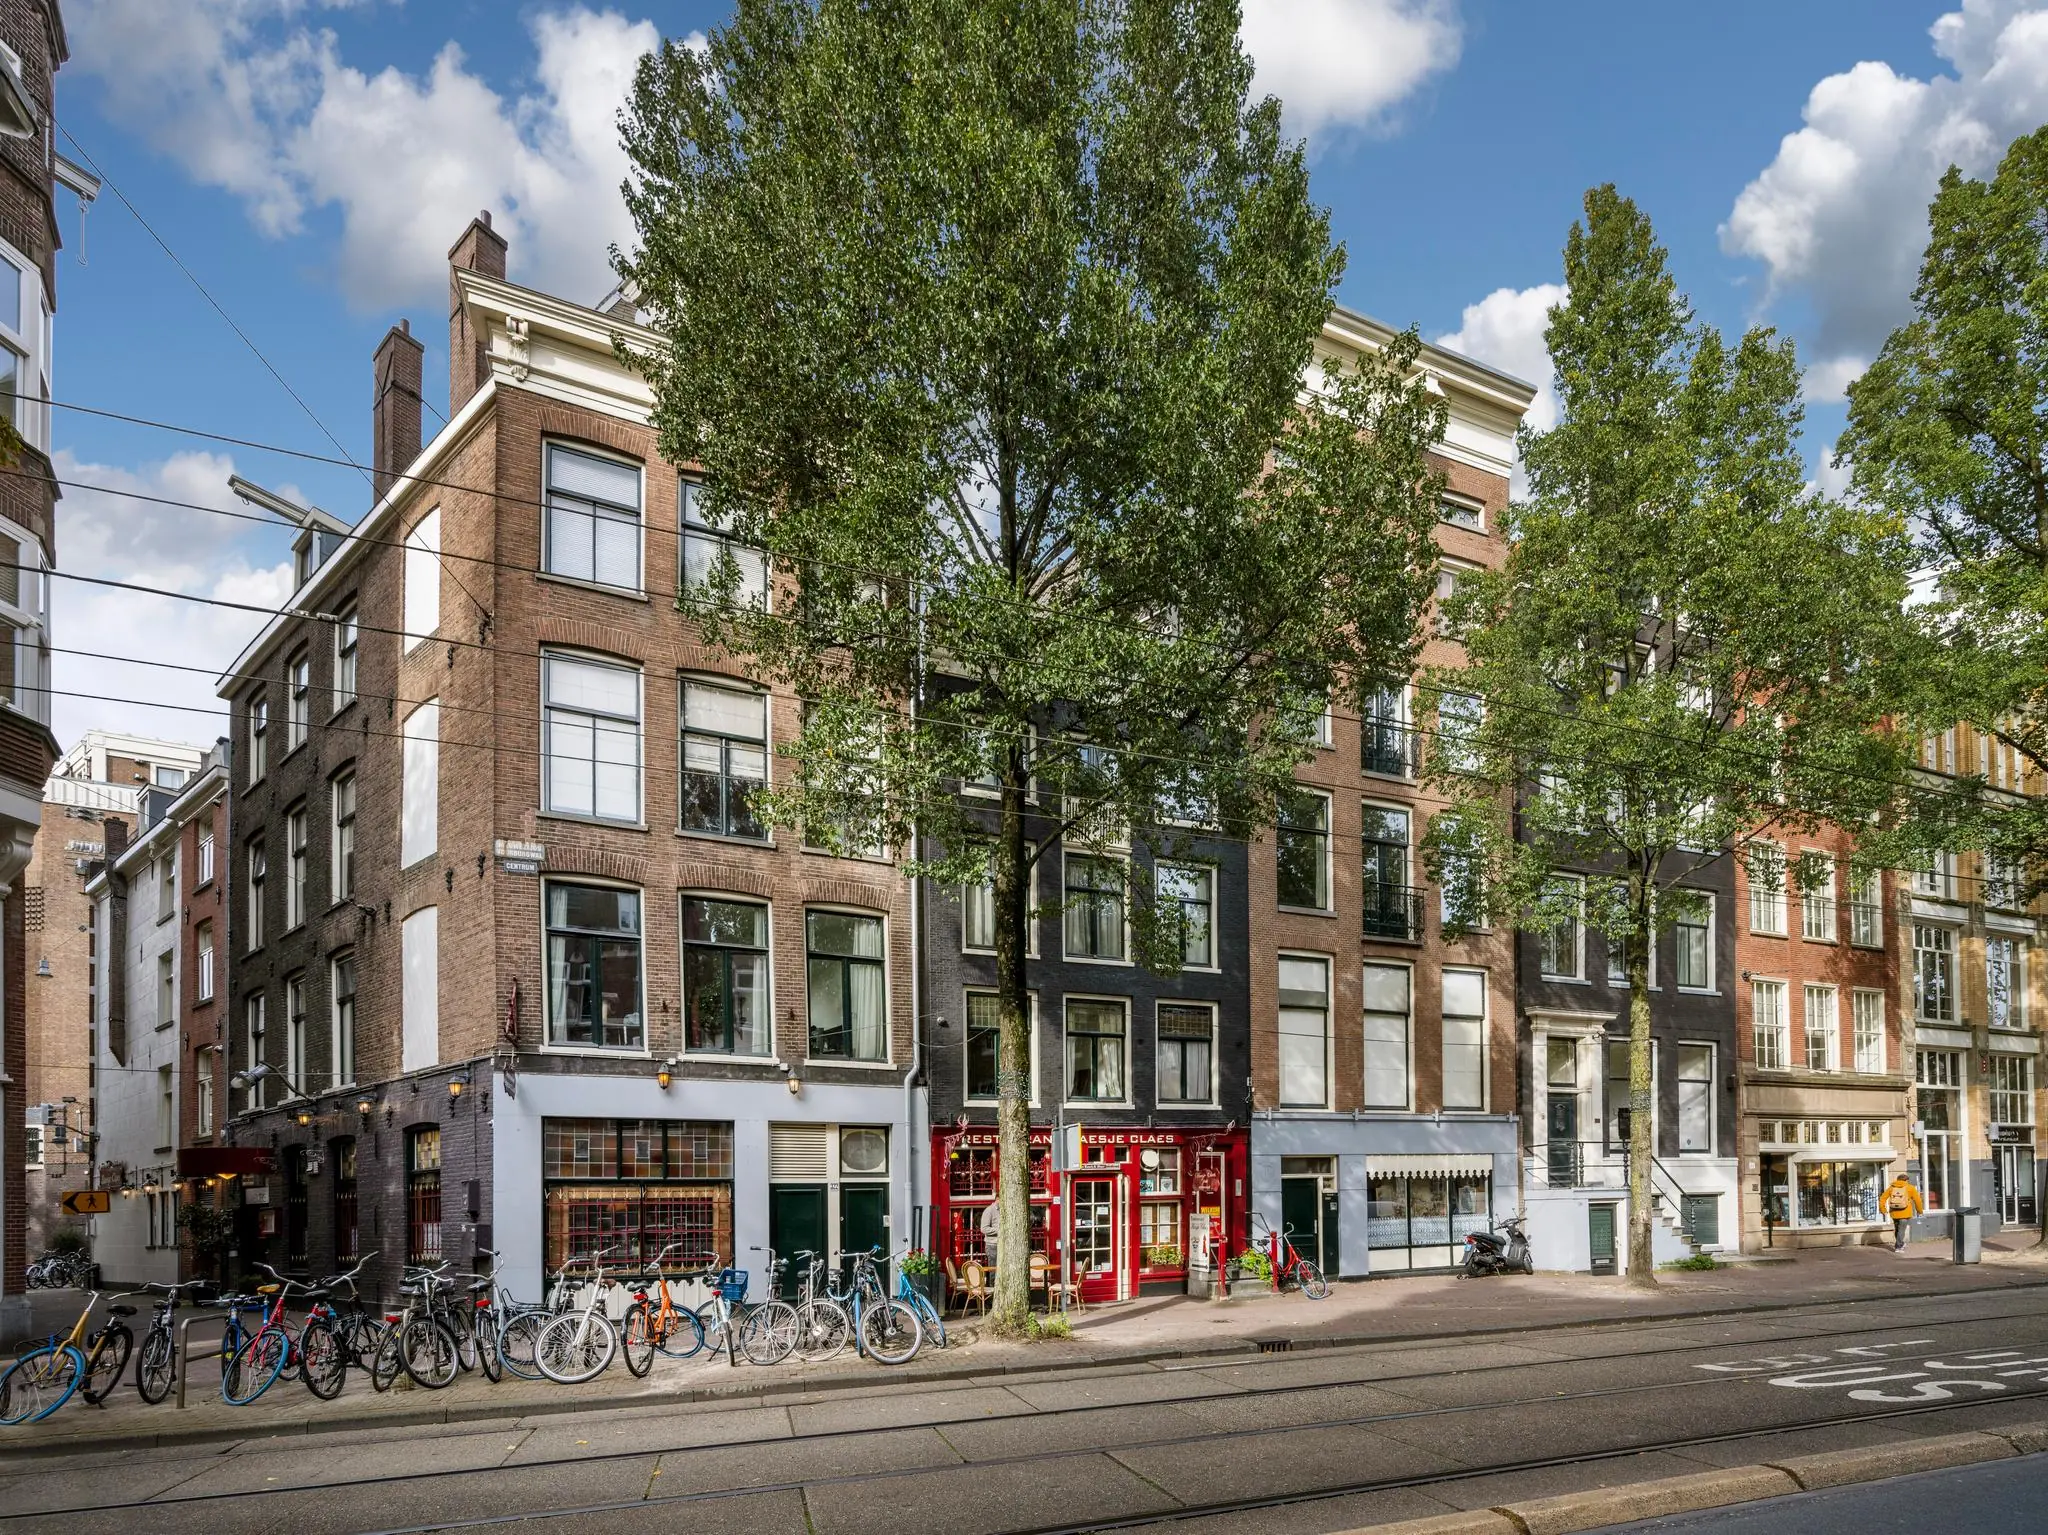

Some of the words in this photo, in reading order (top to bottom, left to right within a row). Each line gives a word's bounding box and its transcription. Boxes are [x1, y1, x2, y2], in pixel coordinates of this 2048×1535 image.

[506, 862, 535, 871] CENTRUM
[1081, 1134, 1125, 1144] AESJE
[1130, 1134, 1174, 1144] CLAES
